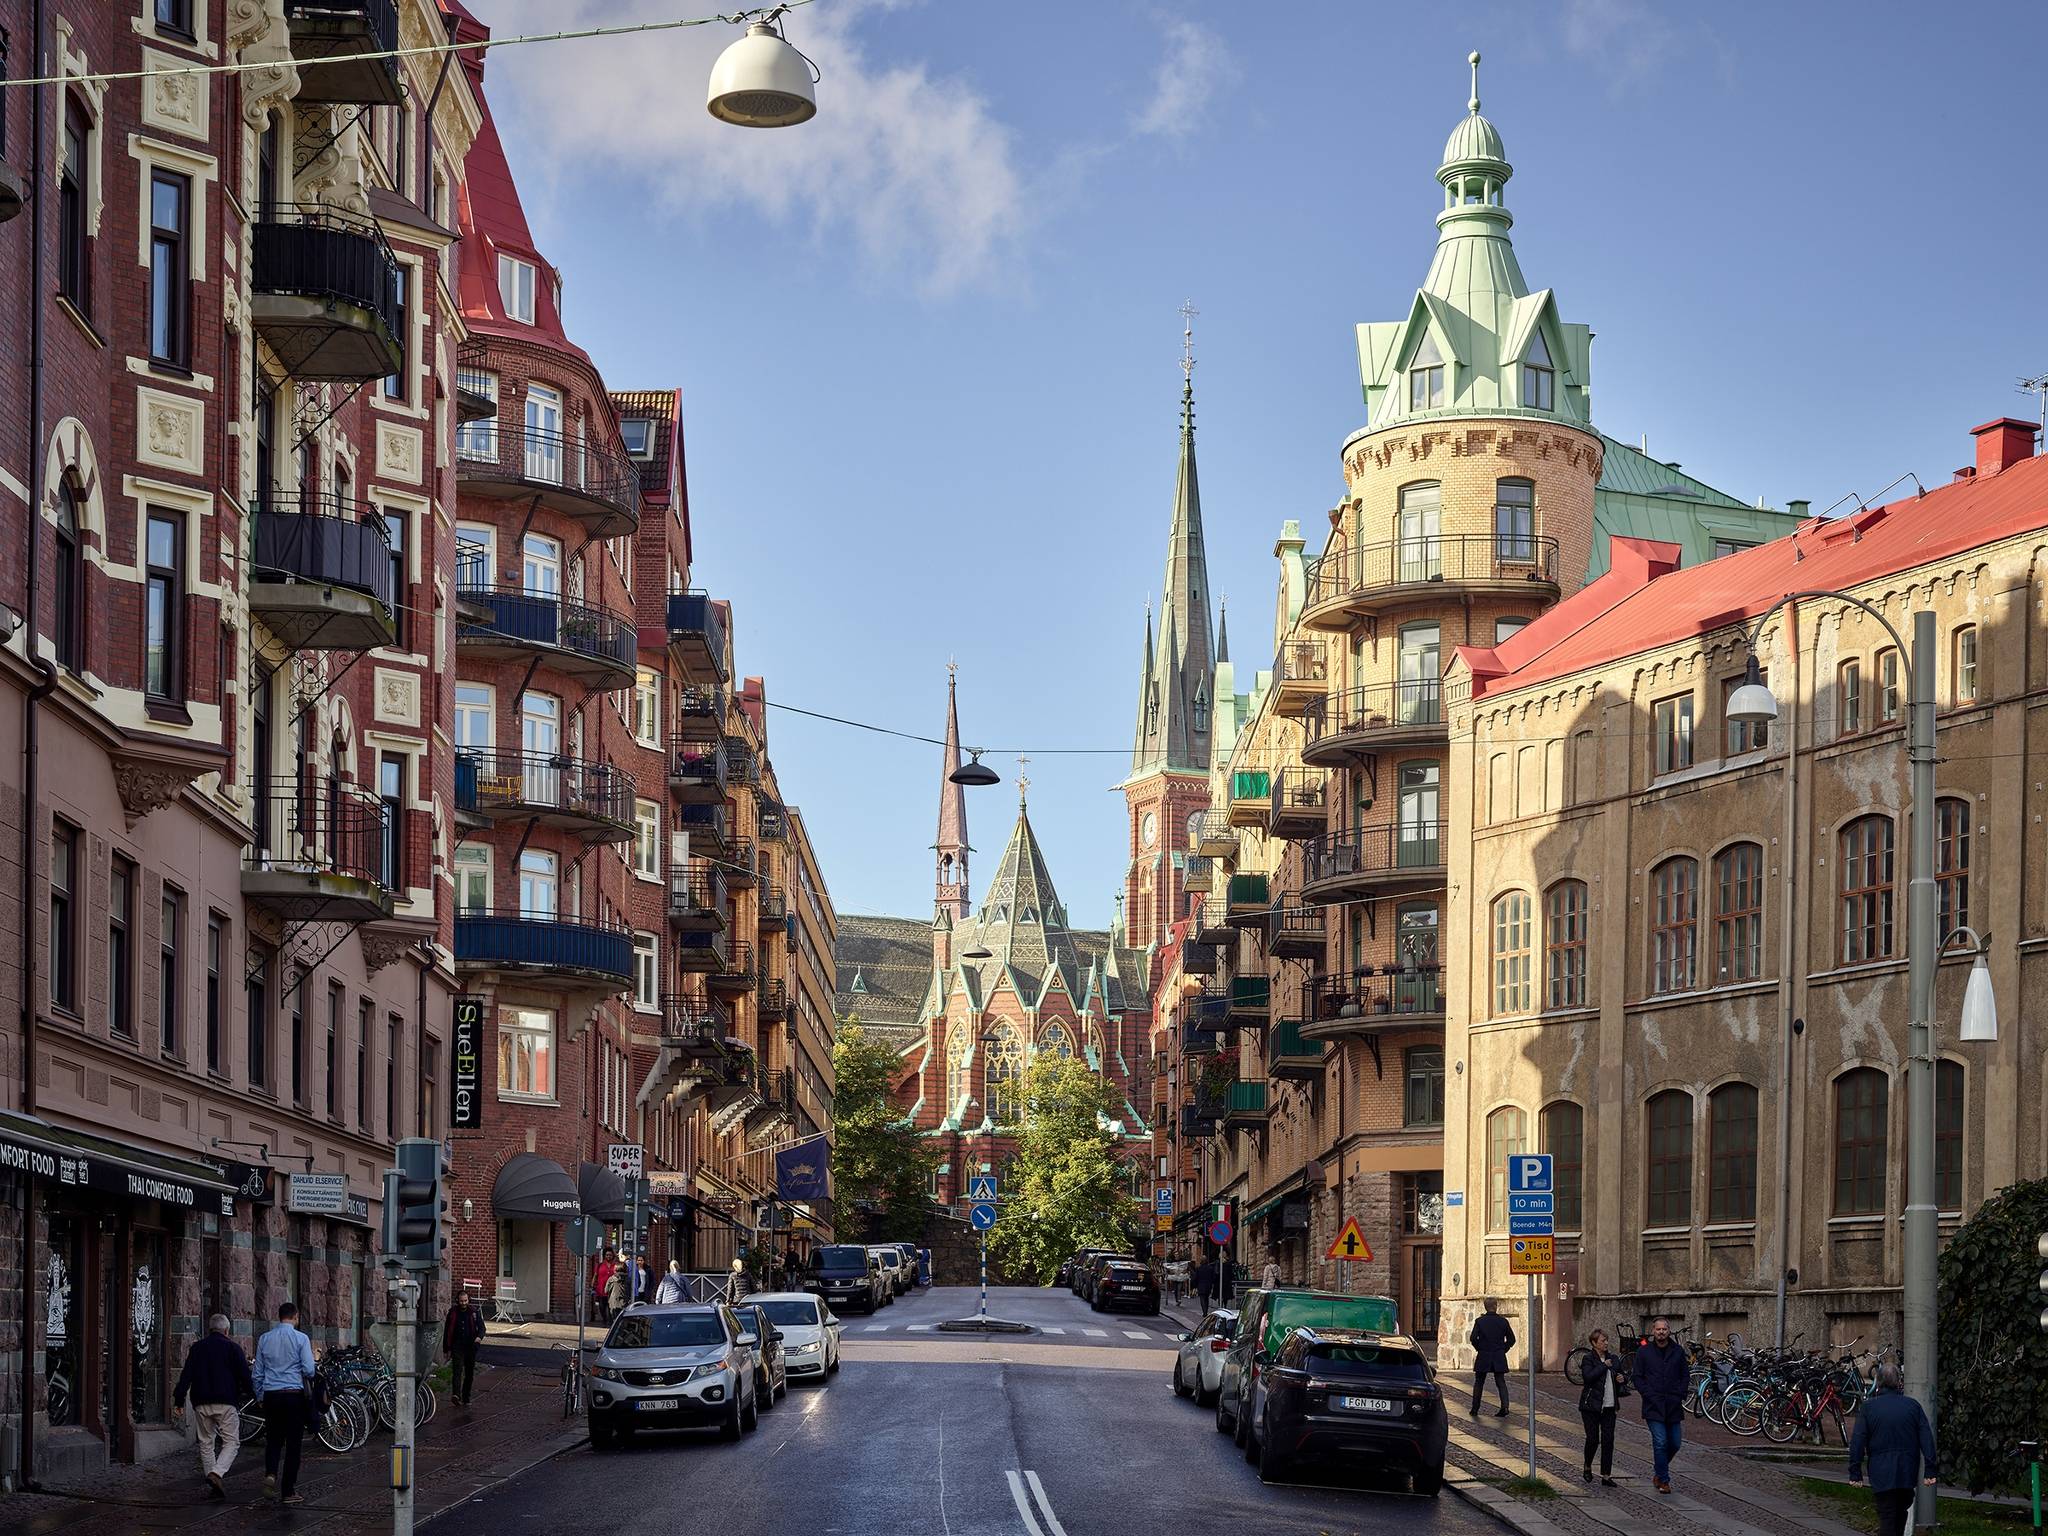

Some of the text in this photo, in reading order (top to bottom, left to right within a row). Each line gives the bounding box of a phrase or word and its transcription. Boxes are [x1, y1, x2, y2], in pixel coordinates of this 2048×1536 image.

[456, 1005, 477, 1123] SueEllen
[611, 1147, 640, 1160] SUPER
[0, 1143, 30, 1171] MFORT
[31, 1151, 55, 1177] FOOD
[1521, 1158, 1543, 1189] P
[315, 1177, 343, 1185] ELSERVICE
[127, 1174, 194, 1206] THAI COMFORT FOOD
[1162, 1190, 1169, 1200] P
[542, 1199, 572, 1210] Huggets
[1515, 1199, 1547, 1208] 10 min
[1527, 1241, 1549, 1250] Tisd
